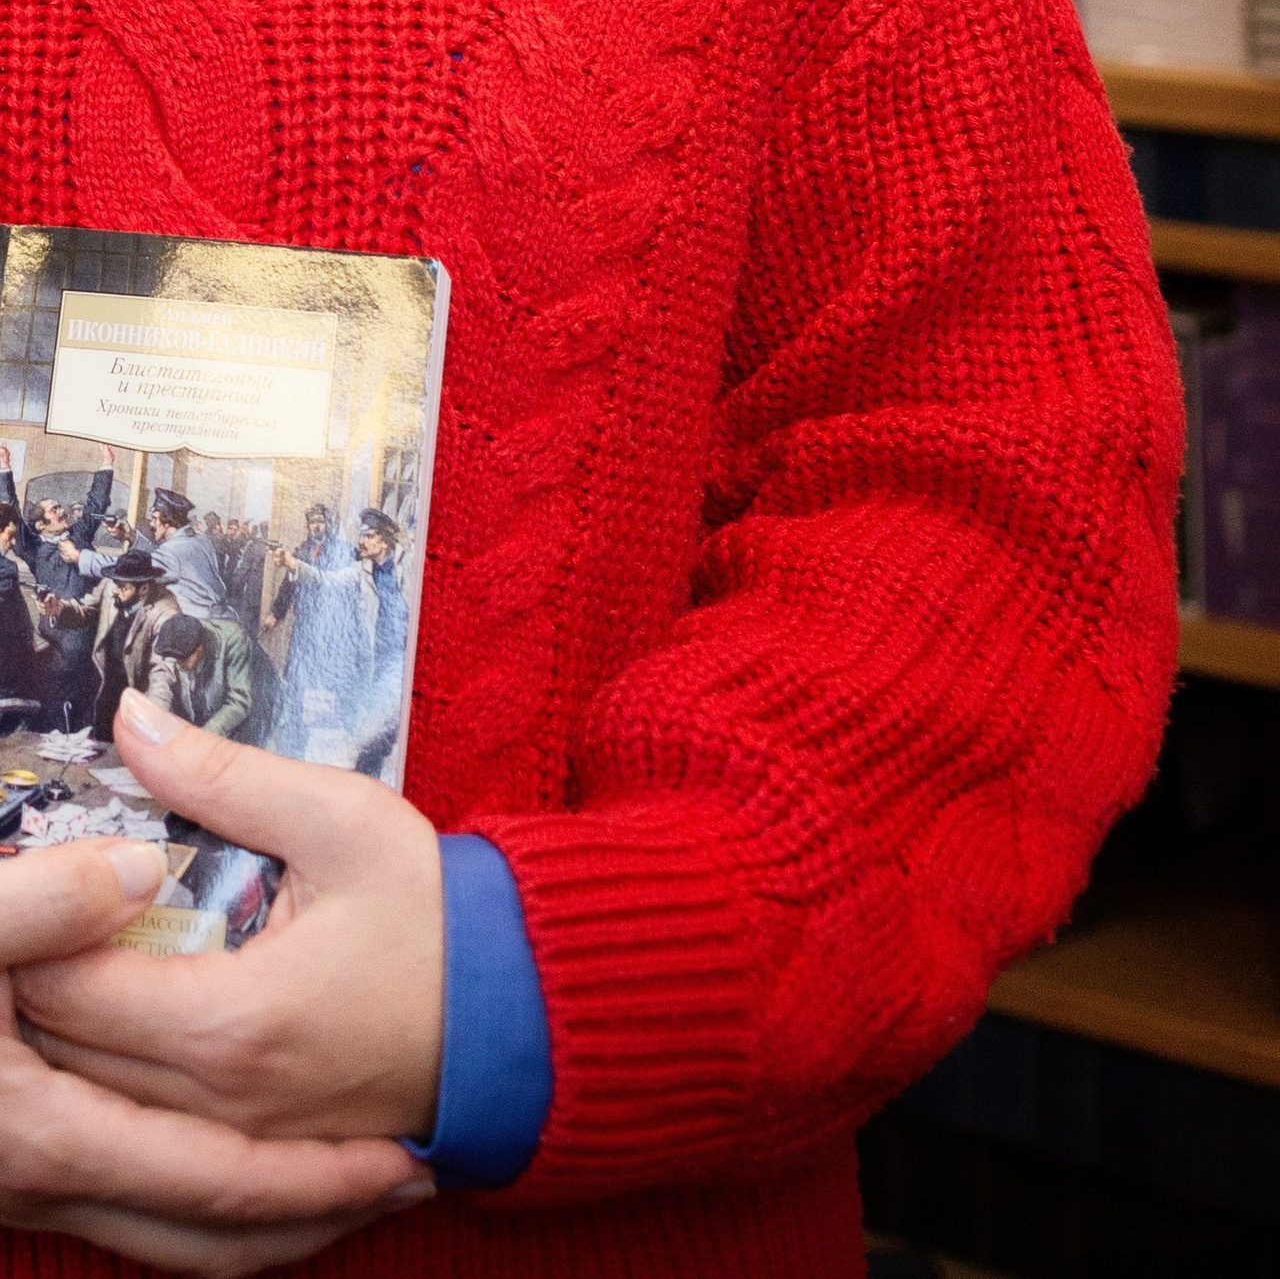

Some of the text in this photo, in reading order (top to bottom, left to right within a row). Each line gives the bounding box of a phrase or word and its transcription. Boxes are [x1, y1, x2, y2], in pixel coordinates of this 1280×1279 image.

[66, 318, 326, 363] ИКОННИКОВ-ГАЛИЦКИЙ
[110, 357, 275, 390] Блистательный
[117, 380, 262, 405] и преступный
[95, 399, 160, 418] Хроники
